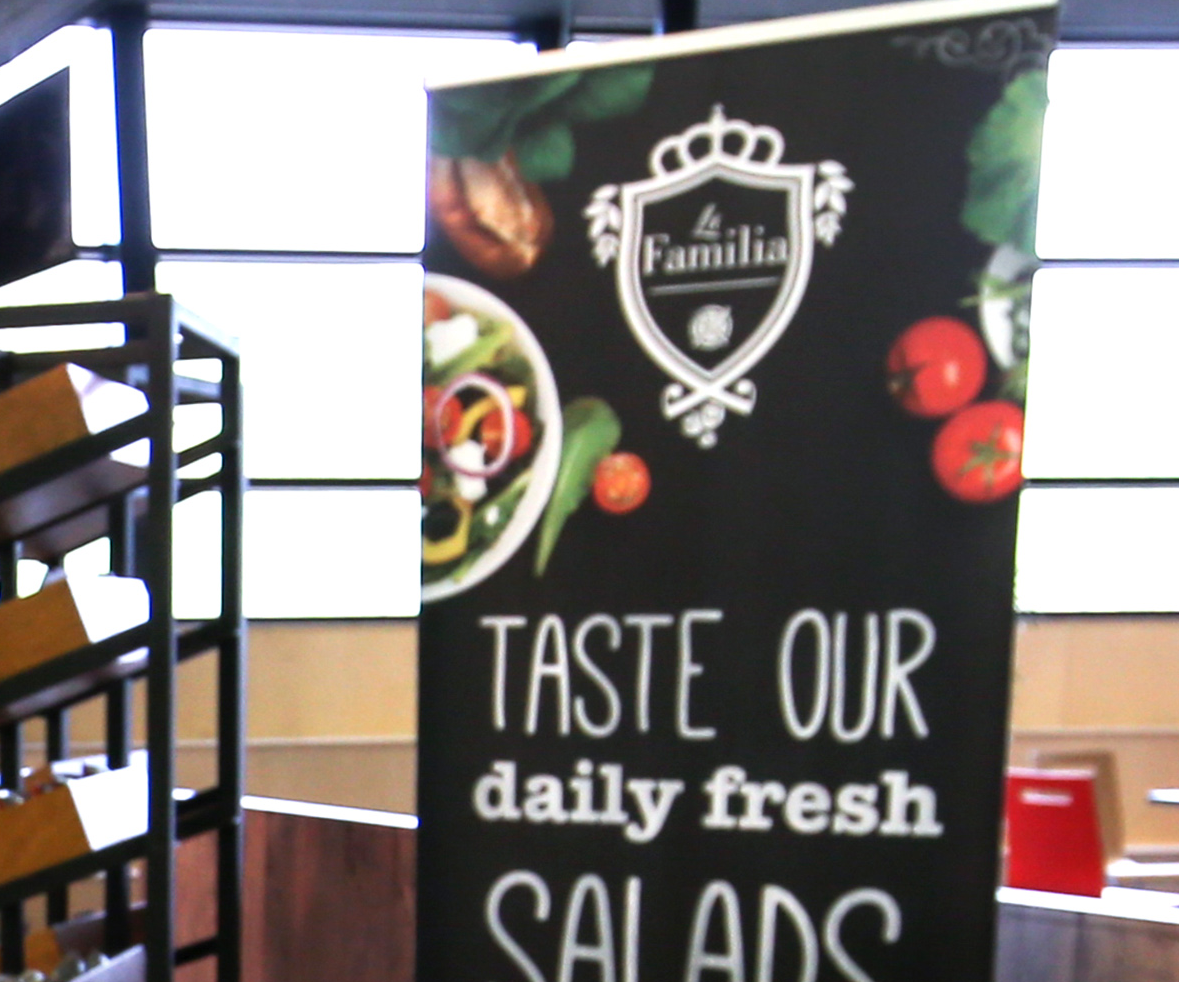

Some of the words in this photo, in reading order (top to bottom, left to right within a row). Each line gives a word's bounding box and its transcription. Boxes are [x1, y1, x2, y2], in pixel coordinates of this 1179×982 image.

[643, 224, 789, 276] Familia
[479, 608, 723, 739] TASTE
[778, 607, 937, 743] OUR
[473, 760, 684, 844] daily
[701, 765, 944, 837] fresh
